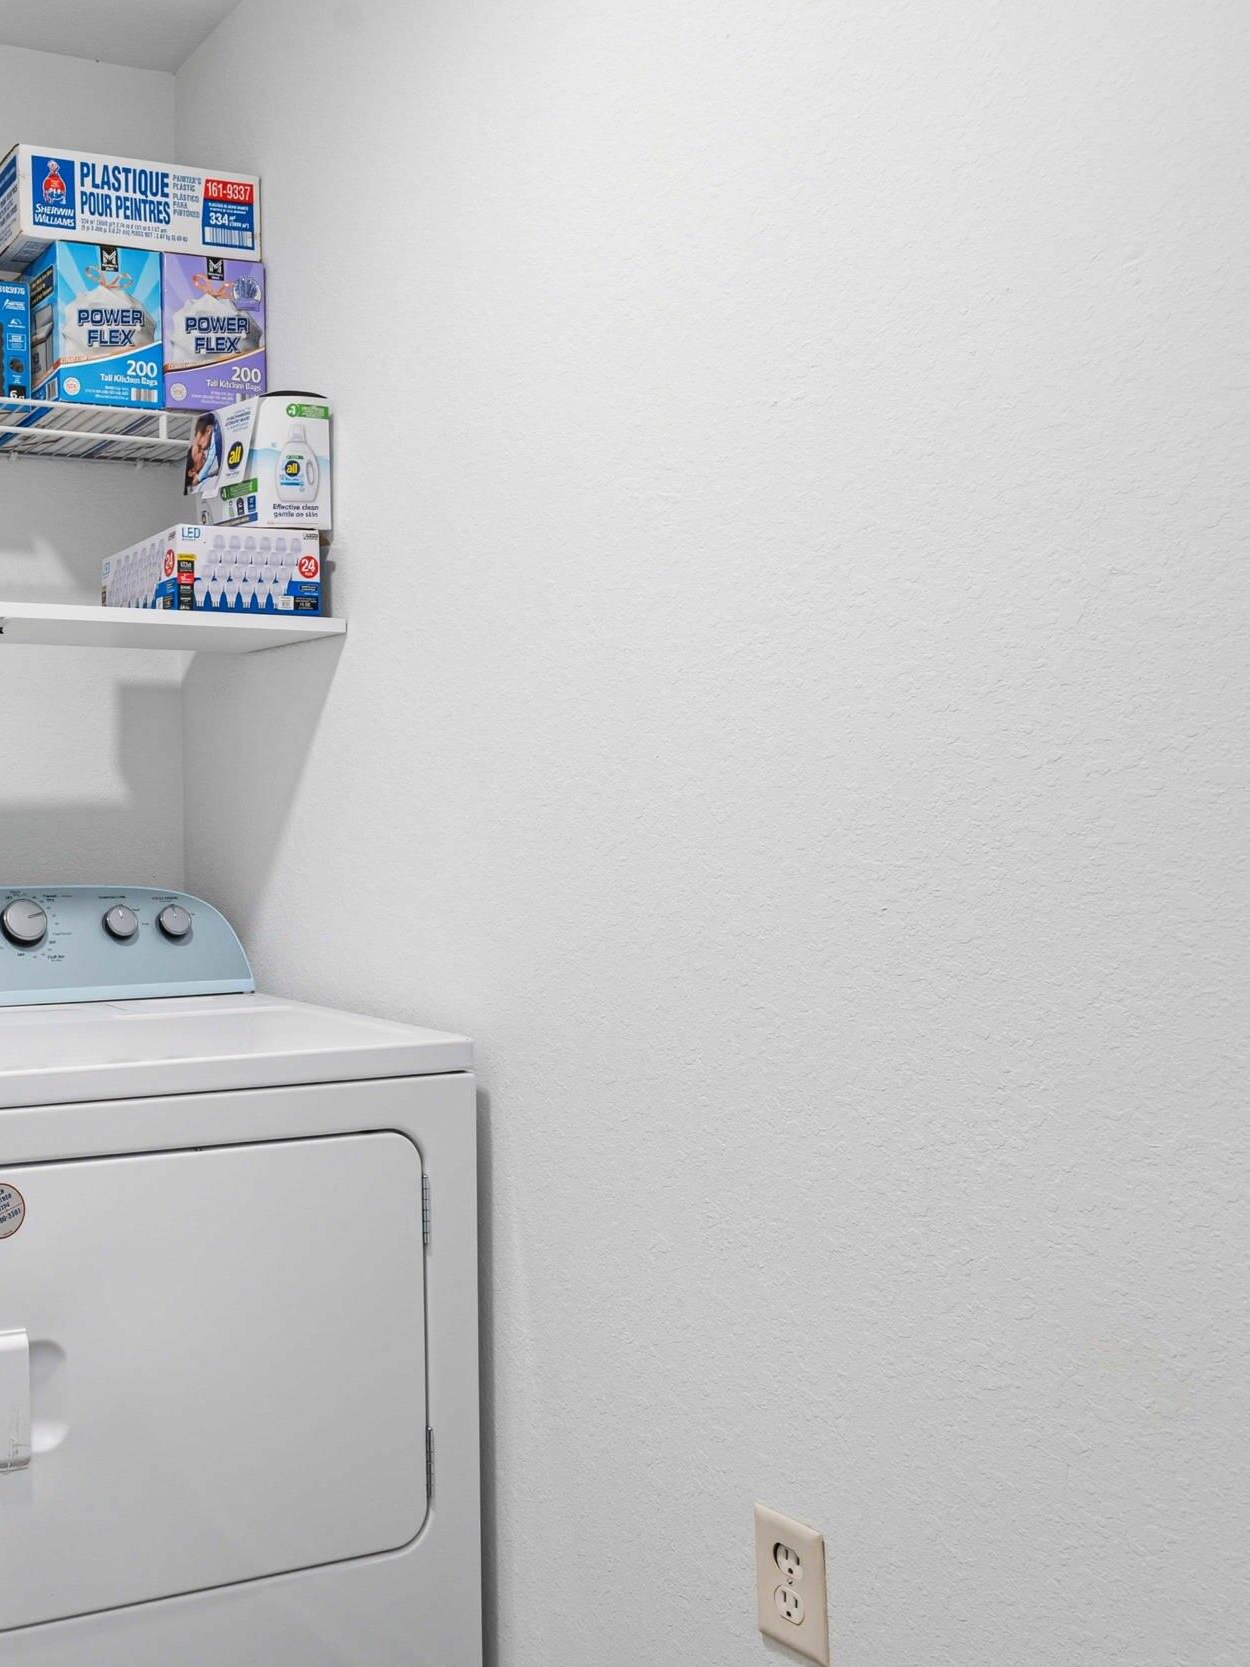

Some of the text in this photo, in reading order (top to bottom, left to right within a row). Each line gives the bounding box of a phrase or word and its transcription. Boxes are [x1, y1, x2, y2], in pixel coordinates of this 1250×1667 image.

[80, 161, 170, 199] PLASTIQUE
[206, 181, 252, 201] 161-9337
[36, 203, 75, 217] SHERWIN
[80, 190, 171, 225] POUR PEINTRES
[34, 213, 75, 227] WILLIAMS
[209, 212, 229, 226] 334
[78, 309, 145, 327] POWER
[185, 316, 251, 335] POWER
[87, 329, 136, 348] FLEX
[194, 336, 241, 354] FLEX
[126, 359, 159, 378] 200
[231, 366, 262, 383] 200
[100, 373, 159, 387] Tall Kitchen Bags
[206, 379, 262, 392] Tall Kitchen Bags
[228, 446, 242, 465] all
[285, 463, 298, 474] all
[272, 503, 319, 512] Effective clean
[273, 511, 295, 519] gentle
[305, 511, 319, 519] skin
[181, 526, 201, 539] LED
[300, 558, 316, 573] 24
